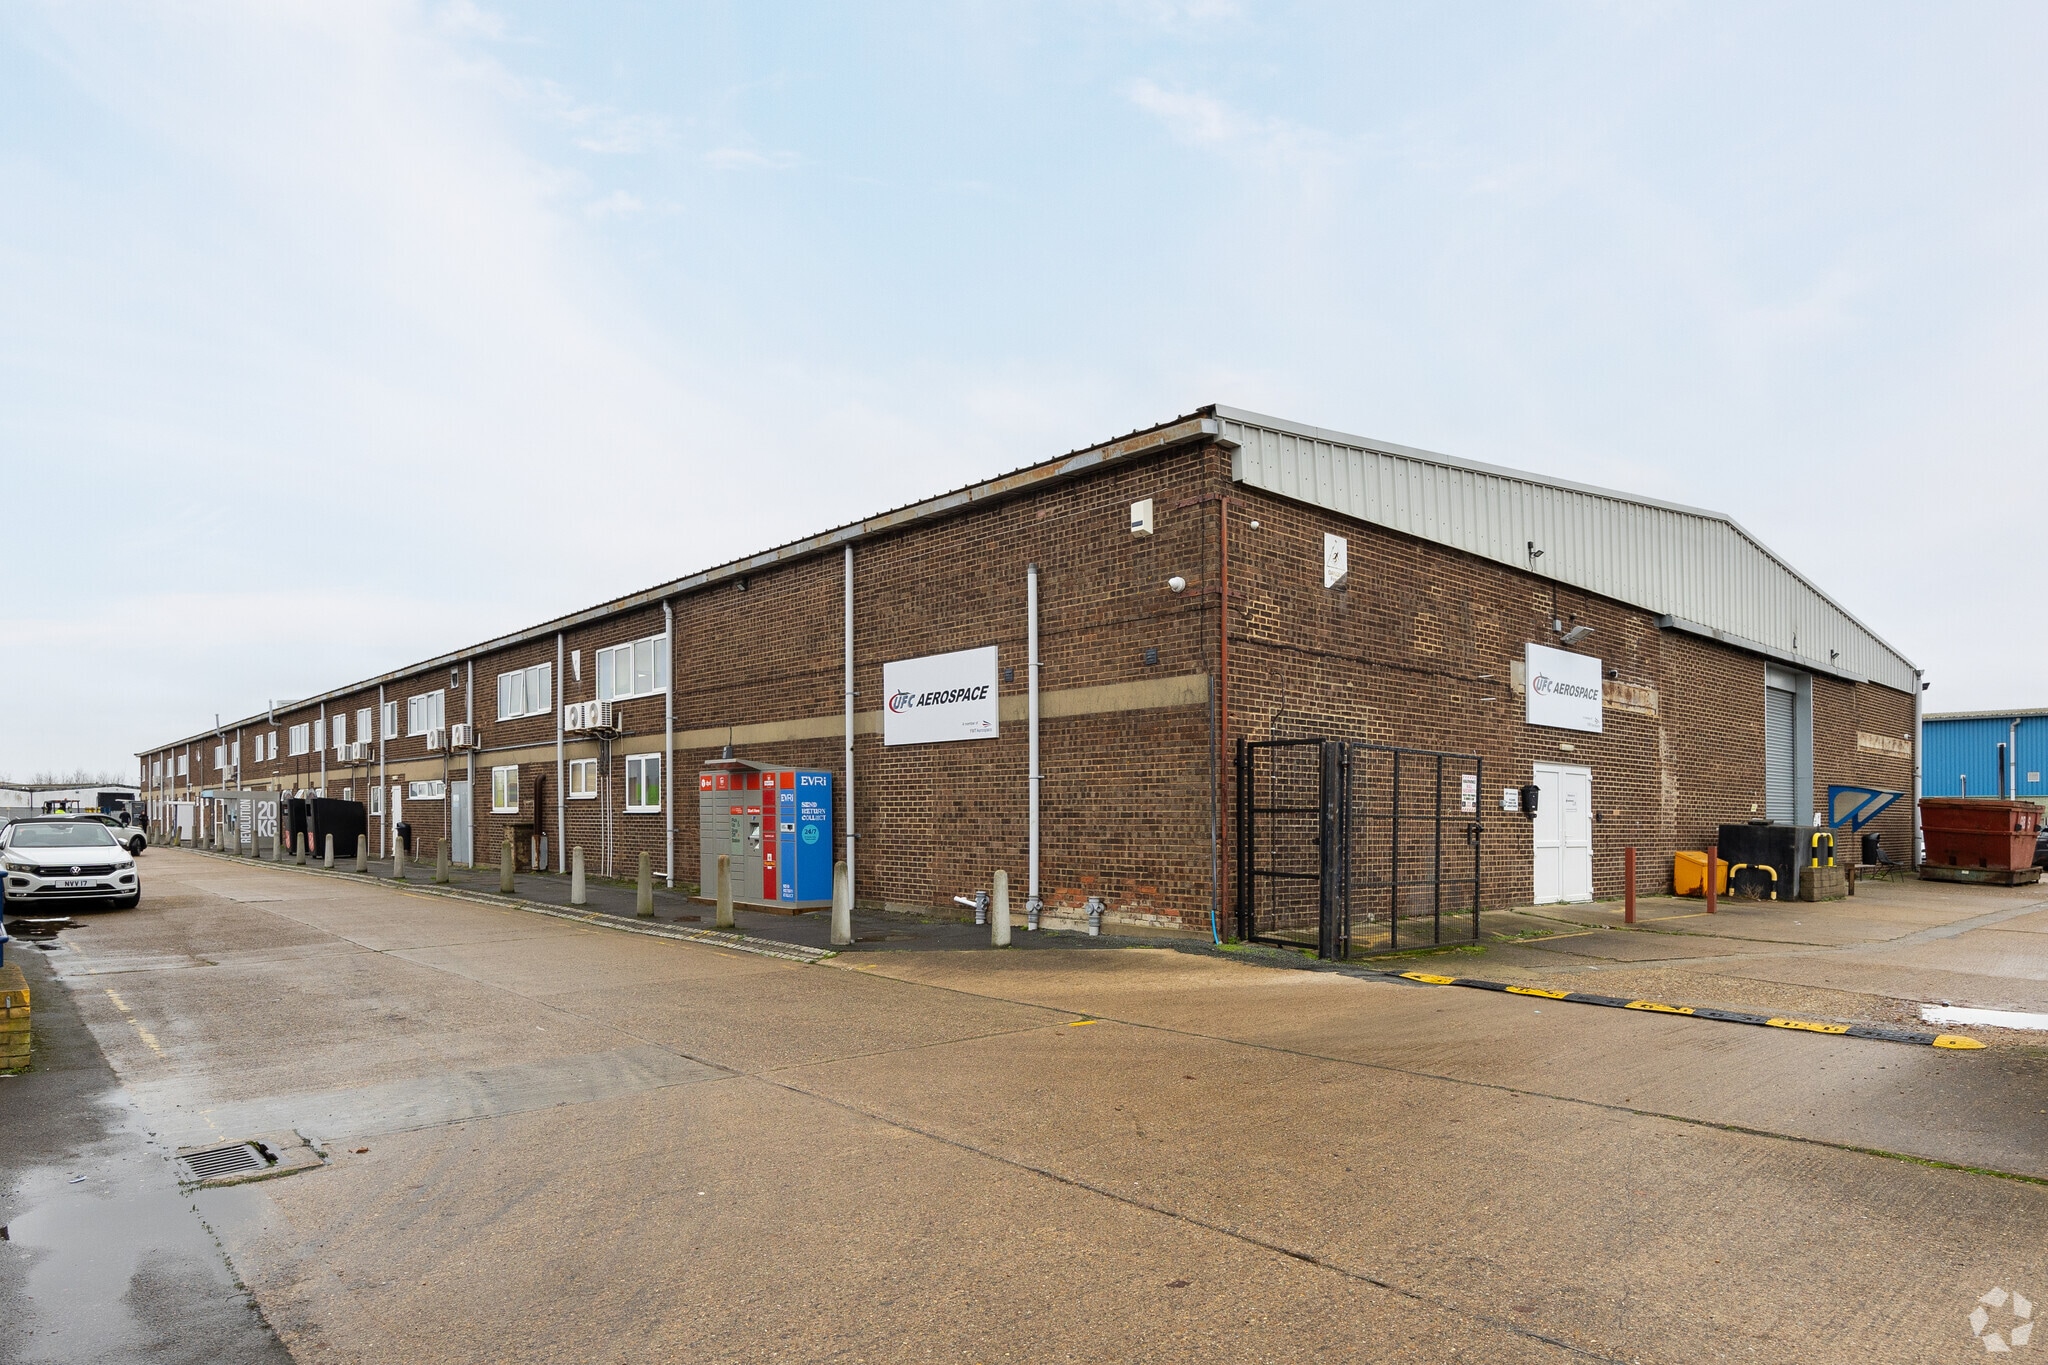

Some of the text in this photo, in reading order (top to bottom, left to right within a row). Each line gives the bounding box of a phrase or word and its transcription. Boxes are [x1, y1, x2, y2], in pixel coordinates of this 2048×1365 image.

[893, 685, 990, 710] UFC AEROSPACE
[1536, 678, 1599, 701] UFC AEROSPACE
[240, 799, 251, 844] REVOLUTION
[257, 801, 277, 820] 20
[257, 820, 278, 837] KG
